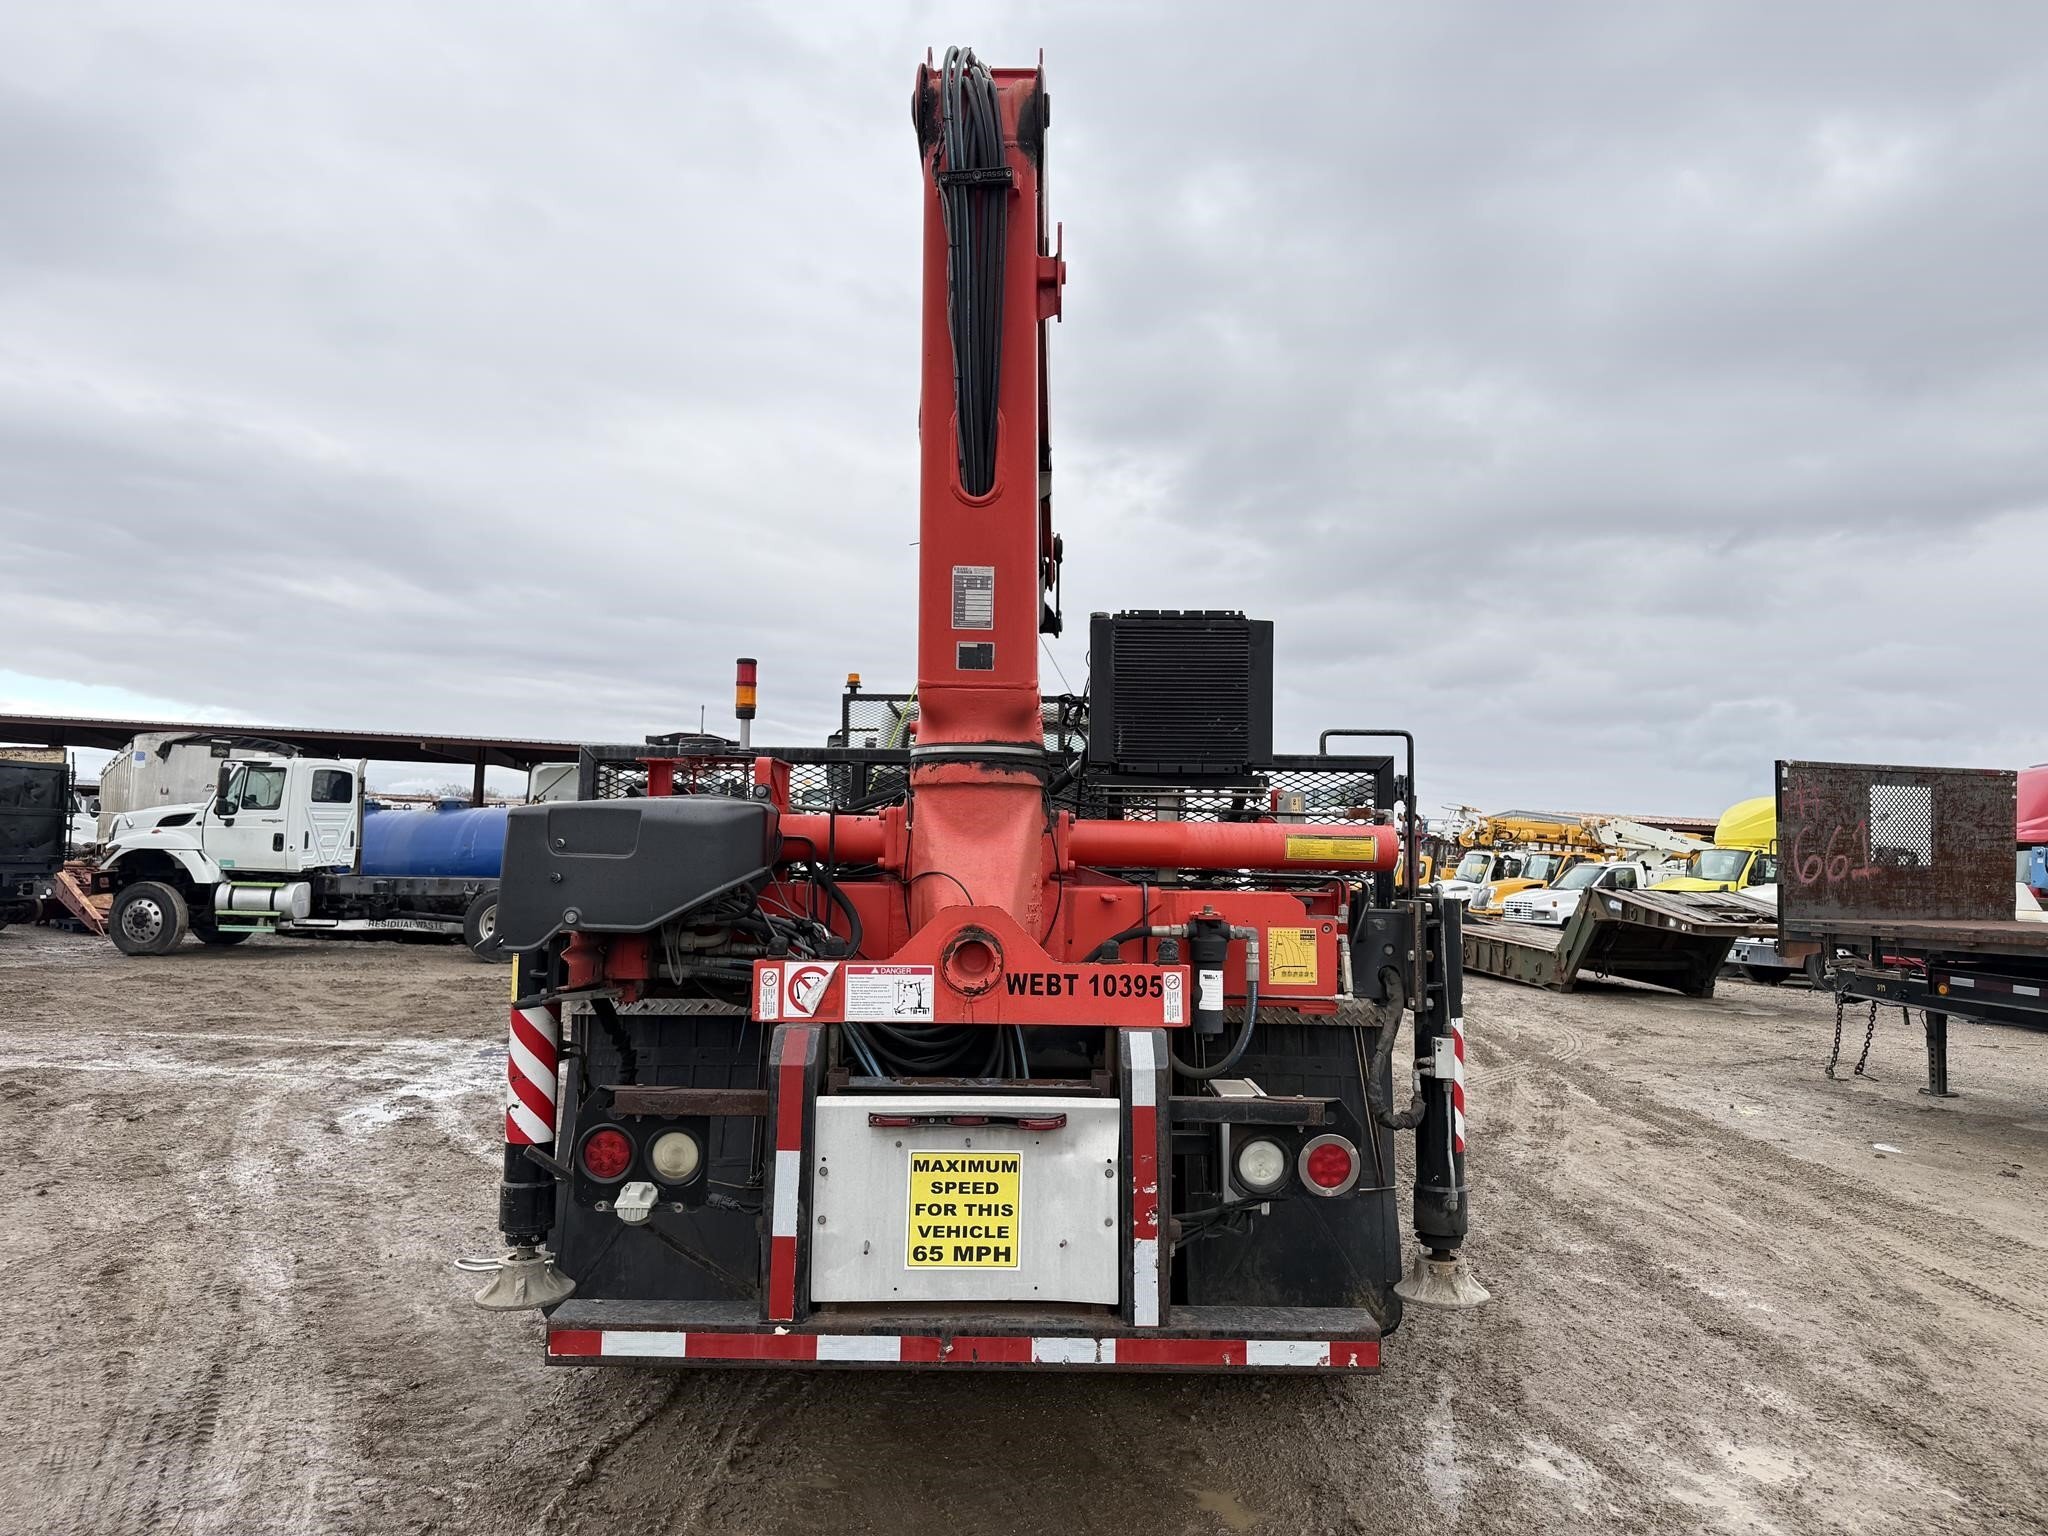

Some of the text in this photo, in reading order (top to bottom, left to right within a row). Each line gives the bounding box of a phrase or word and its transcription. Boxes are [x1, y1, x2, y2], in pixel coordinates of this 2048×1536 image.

[982, 170, 1004, 178] FASSI
[1793, 819, 1881, 884] 661
[368, 919, 442, 930] RESIDUAL WASTE
[880, 967, 912, 975] DANGER
[1006, 973, 1164, 998] WEBT 10395
[913, 1159, 1018, 1173] MAXIMUM
[930, 1181, 999, 1195] SPEED
[915, 1203, 1014, 1217] FOR THIS
[918, 1225, 1010, 1239] VEHICLE
[912, 1245, 1011, 1262] 65 MPH
